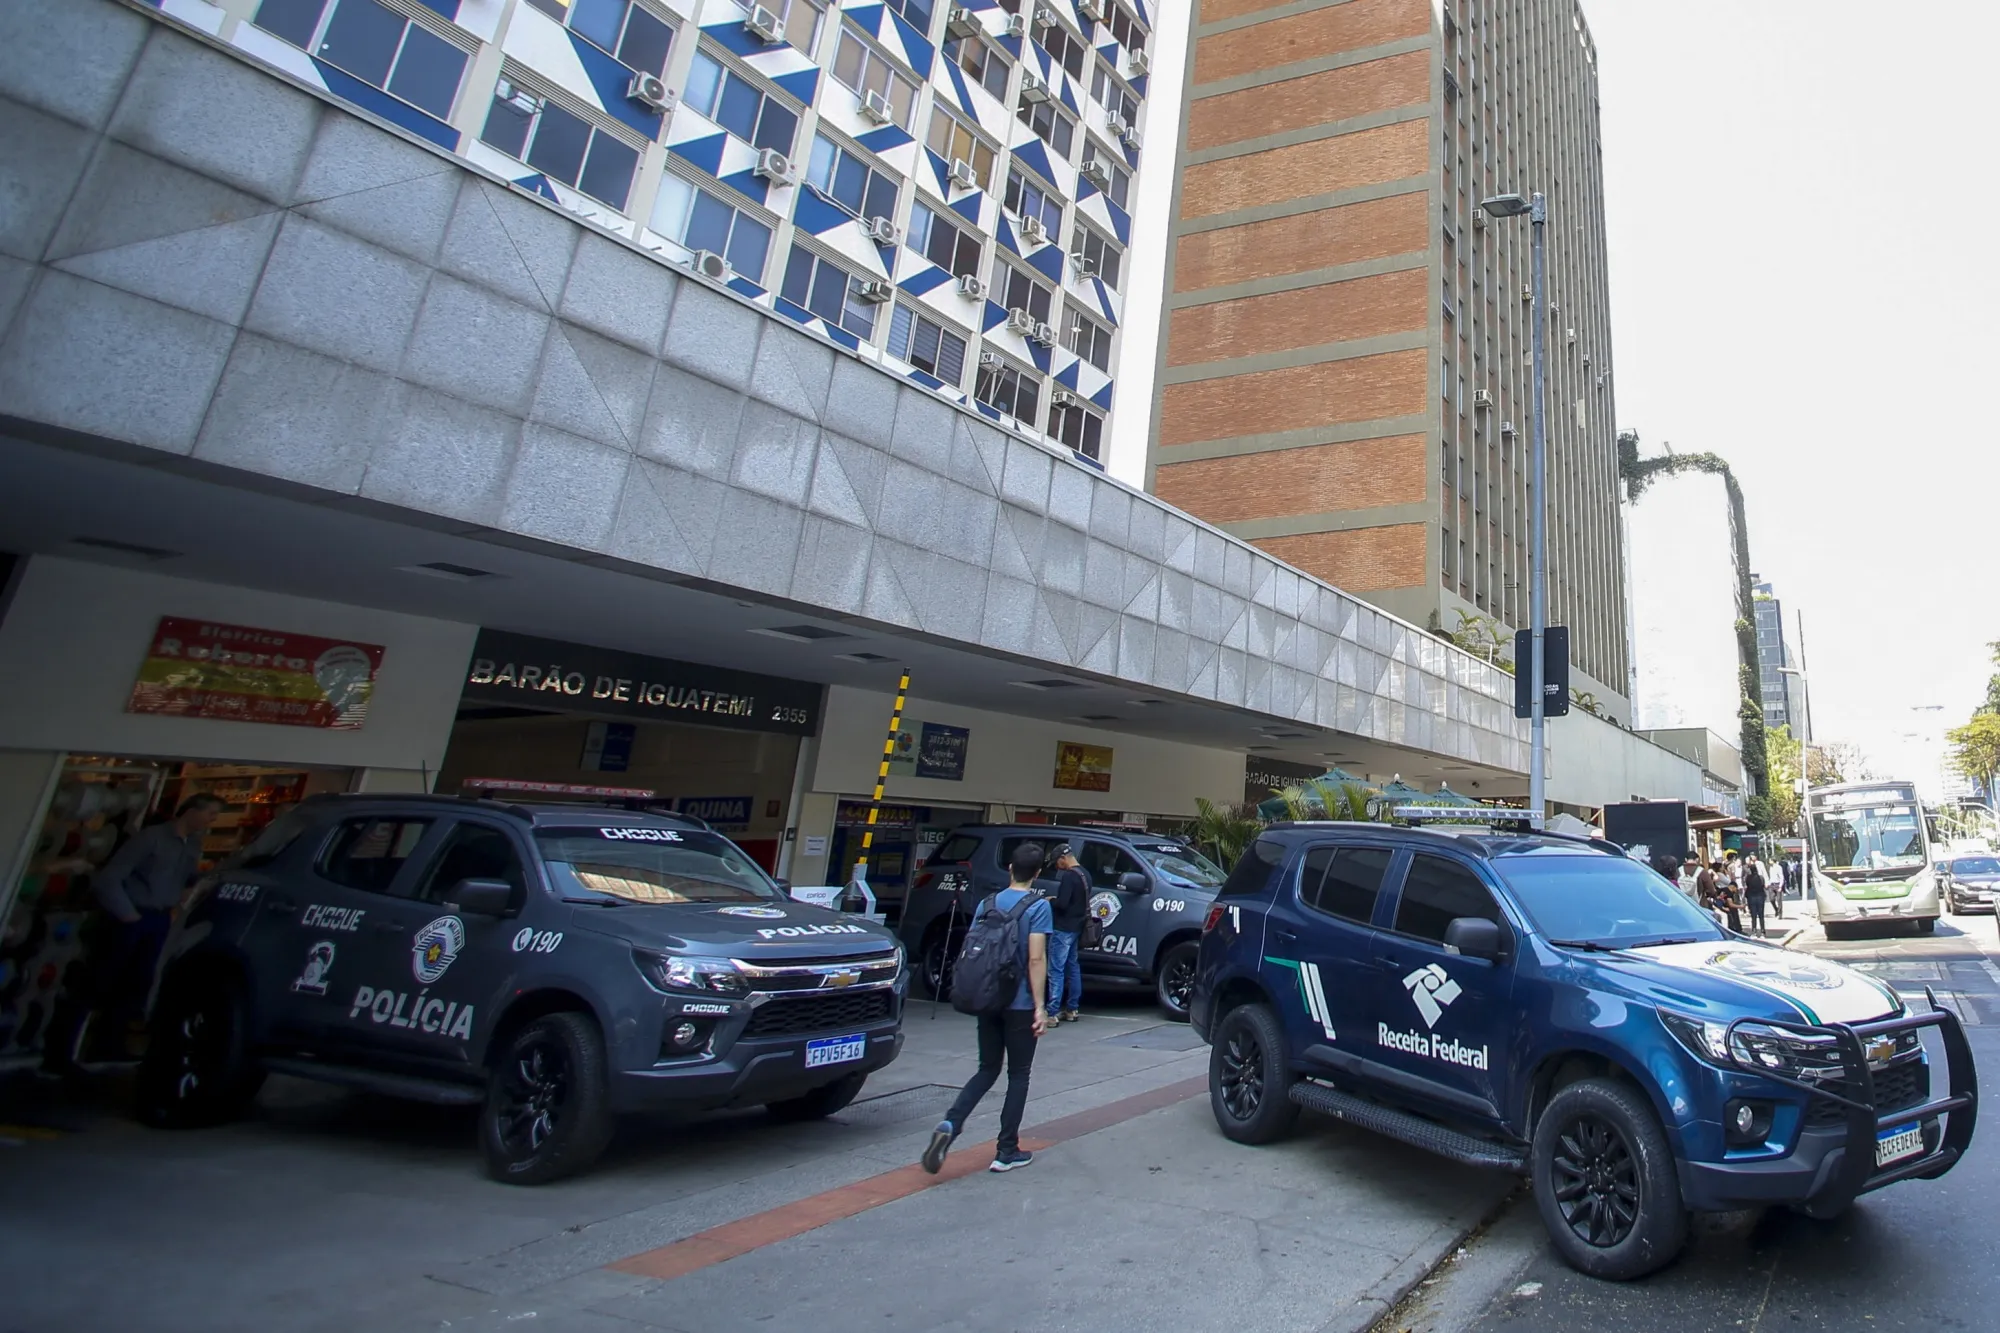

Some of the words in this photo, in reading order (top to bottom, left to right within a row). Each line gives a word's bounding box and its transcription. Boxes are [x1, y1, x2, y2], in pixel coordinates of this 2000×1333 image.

[469, 657, 586, 696] BARÃO
[592, 675, 633, 702] DE
[637, 680, 754, 718] IGUATEMI
[771, 704, 808, 725] 2355
[1270, 775, 1280, 787] DE
[686, 800, 745, 818] QUINA
[600, 827, 684, 843] CHOQUE
[217, 883, 260, 901] 92135
[1165, 900, 1185, 912] 190
[302, 904, 367, 932] CHOQUE
[757, 923, 868, 939] POLÍCIA
[529, 930, 563, 953] 190
[349, 987, 475, 1041] POLÍCIA
[682, 1003, 731, 1015] CHOQUE
[812, 1043, 860, 1064] FPV5F16
[1377, 1021, 1430, 1057] Receita
[1431, 1034, 1488, 1071] Federal
